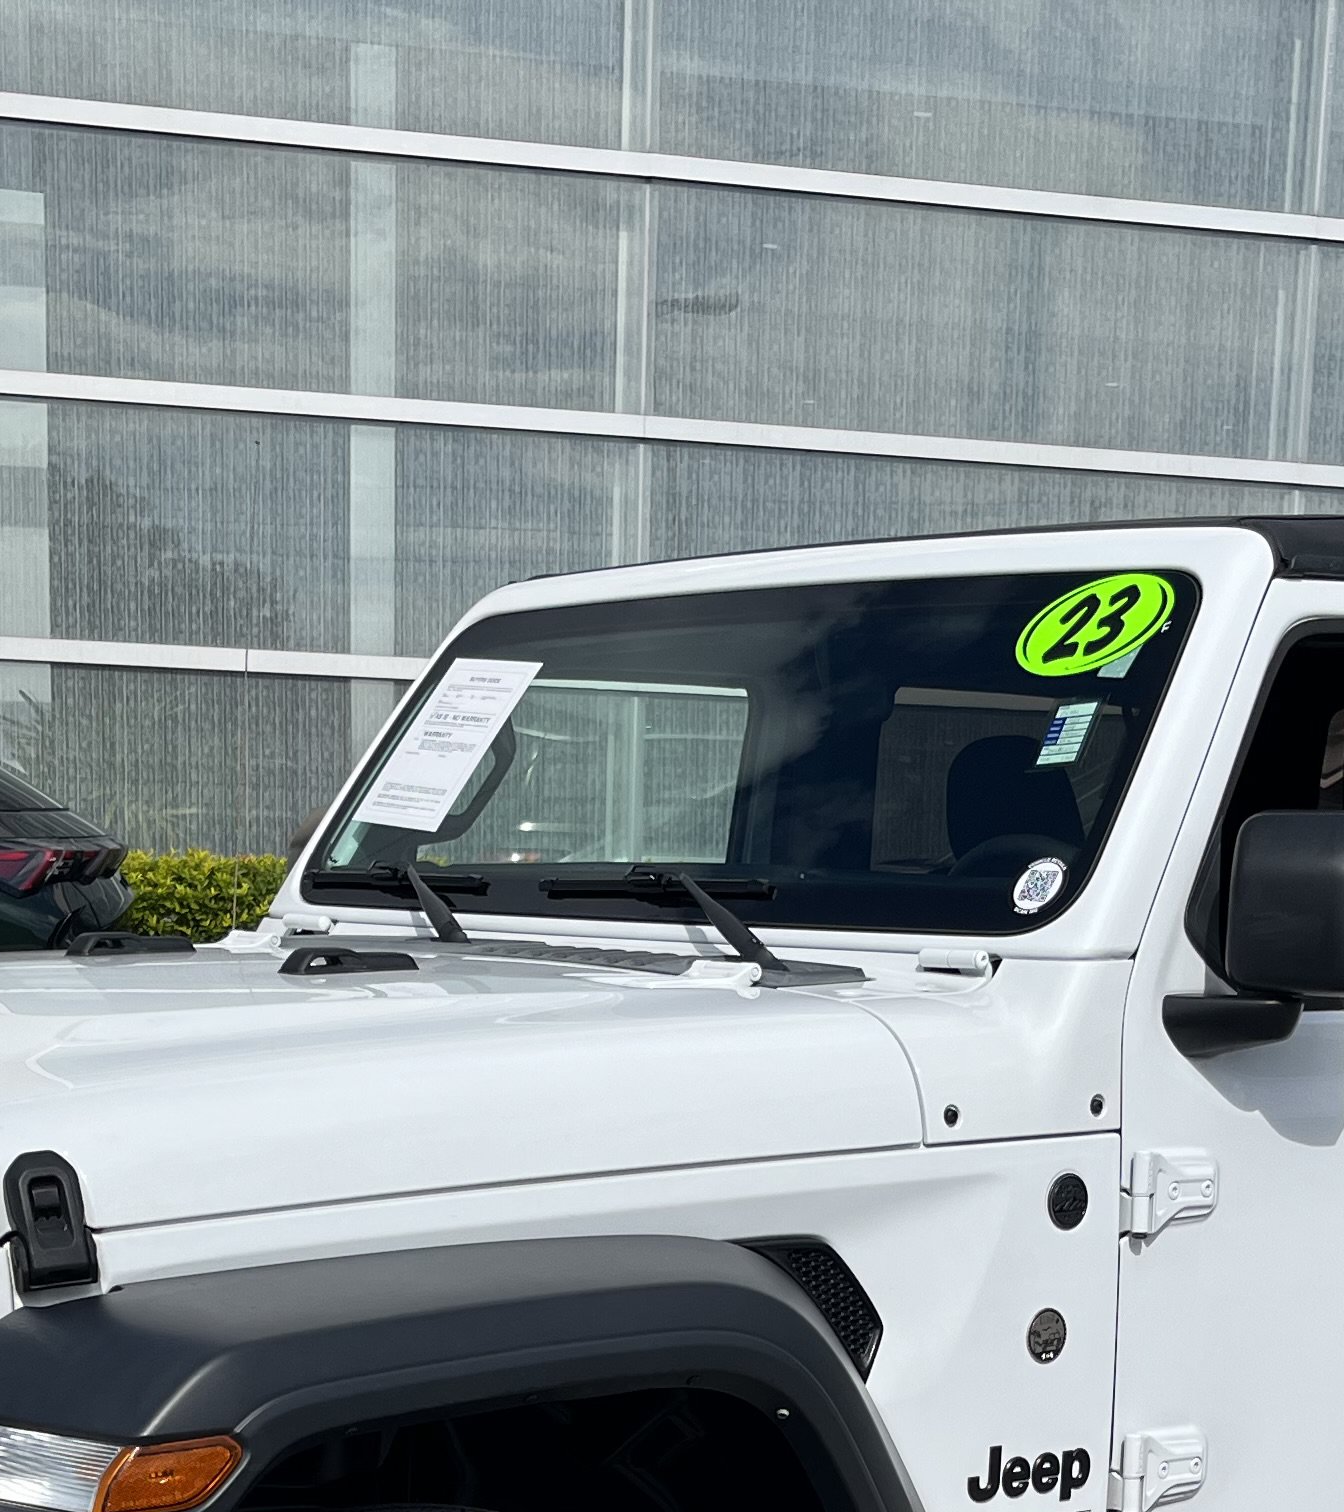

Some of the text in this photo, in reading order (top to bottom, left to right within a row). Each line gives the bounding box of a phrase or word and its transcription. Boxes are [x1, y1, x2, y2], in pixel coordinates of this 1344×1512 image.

[1041, 583, 1142, 664] 23
[423, 730, 454, 738] WARRANTY
[461, 715, 491, 723] WARRANTY
[967, 1444, 1092, 1503] Jeep
